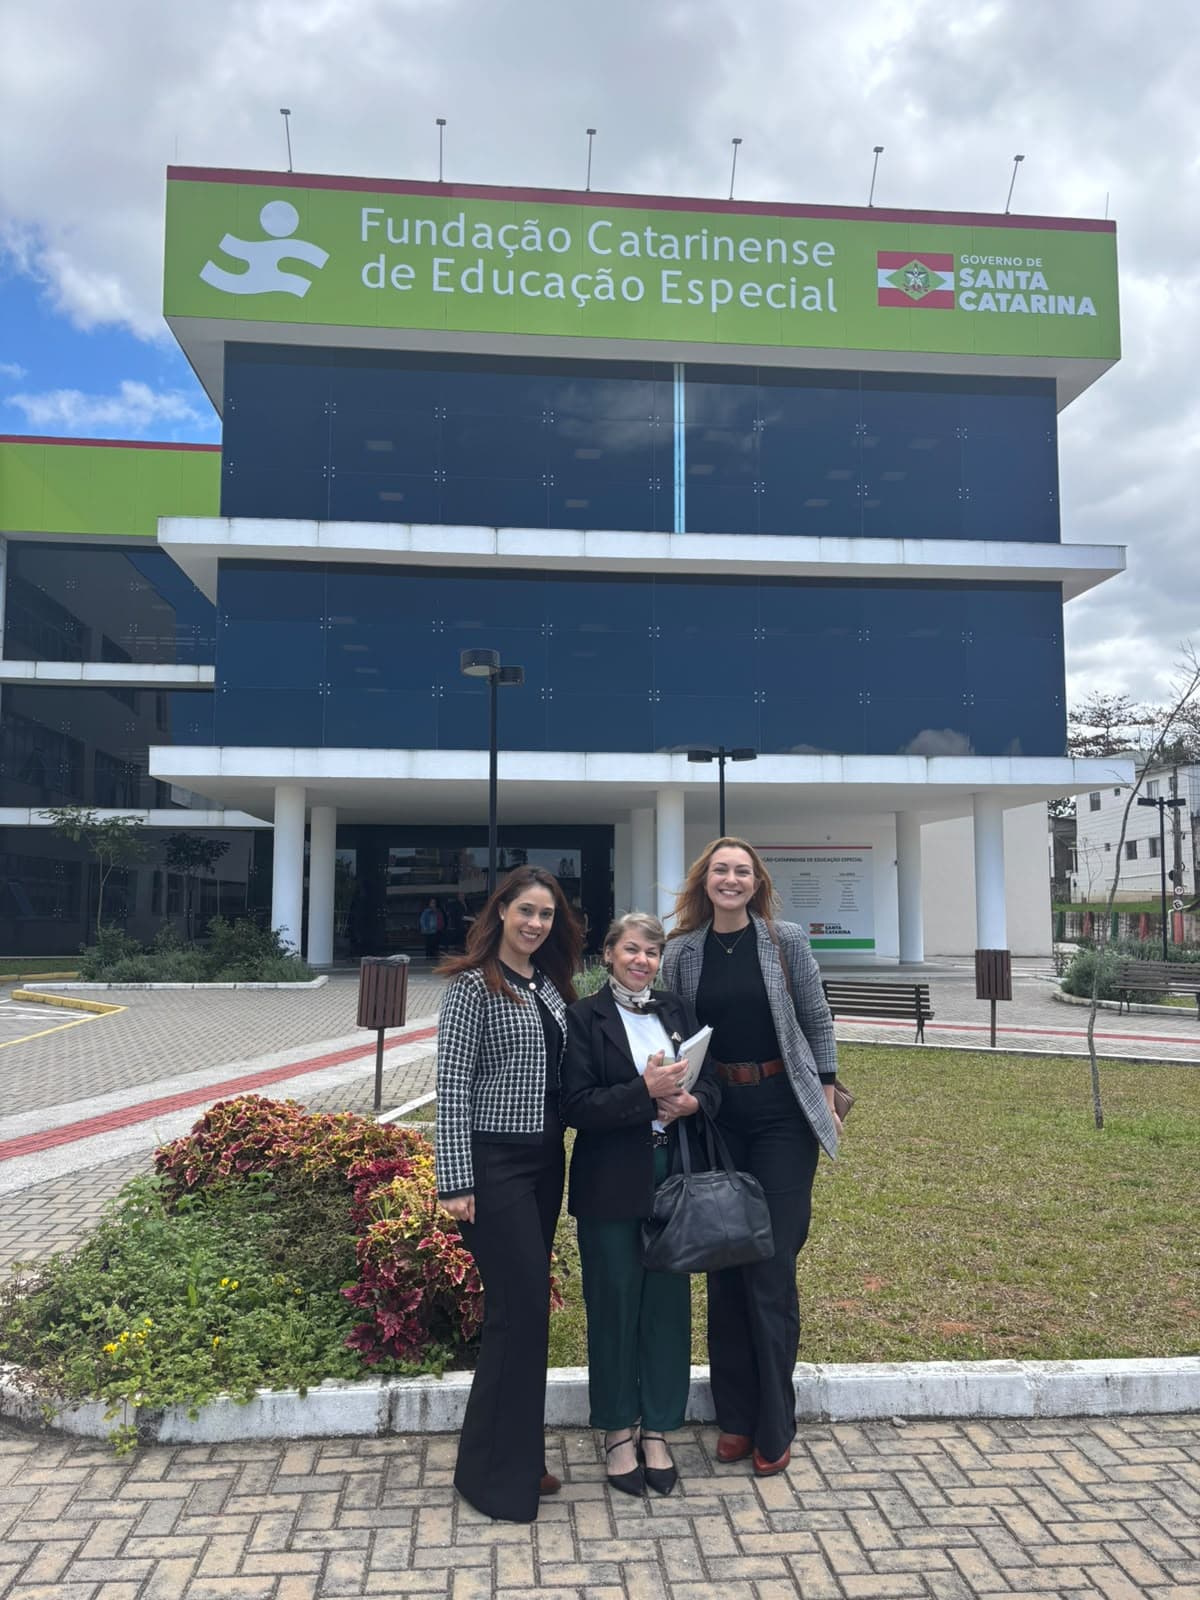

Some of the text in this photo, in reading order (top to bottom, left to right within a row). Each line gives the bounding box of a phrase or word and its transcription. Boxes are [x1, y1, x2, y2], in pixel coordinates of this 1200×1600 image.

[361, 206, 836, 268] Fundação Catarinense
[960, 254, 1042, 268] GOVERNO DE
[361, 254, 838, 314] de Educação Especial
[959, 267, 1049, 290] SANTA
[958, 290, 1097, 317] CATARINA
